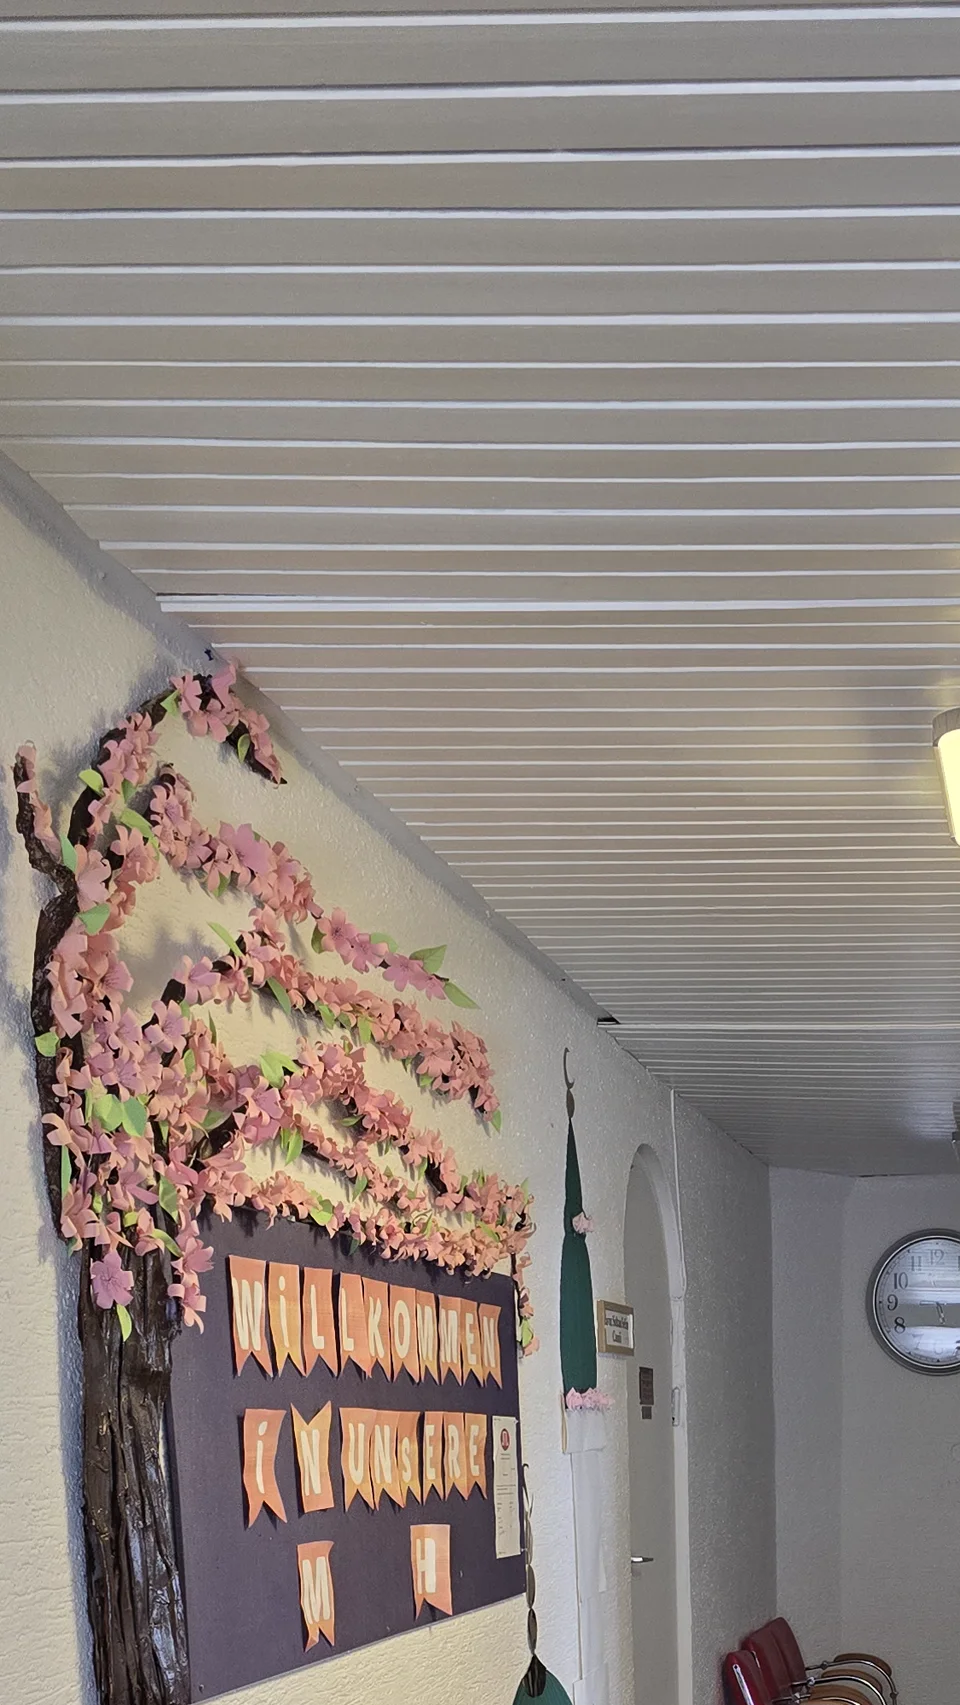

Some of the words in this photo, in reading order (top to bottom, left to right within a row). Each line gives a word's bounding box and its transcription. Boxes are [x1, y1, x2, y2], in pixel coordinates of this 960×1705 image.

[911, 1255, 922, 1272] 11
[930, 1249, 945, 1266] 12
[893, 1272, 909, 1290] 10
[887, 1294, 899, 1311] 9
[893, 1316, 906, 1334] 8
[302, 1556, 332, 1625] M
[416, 1537, 437, 1595] H
